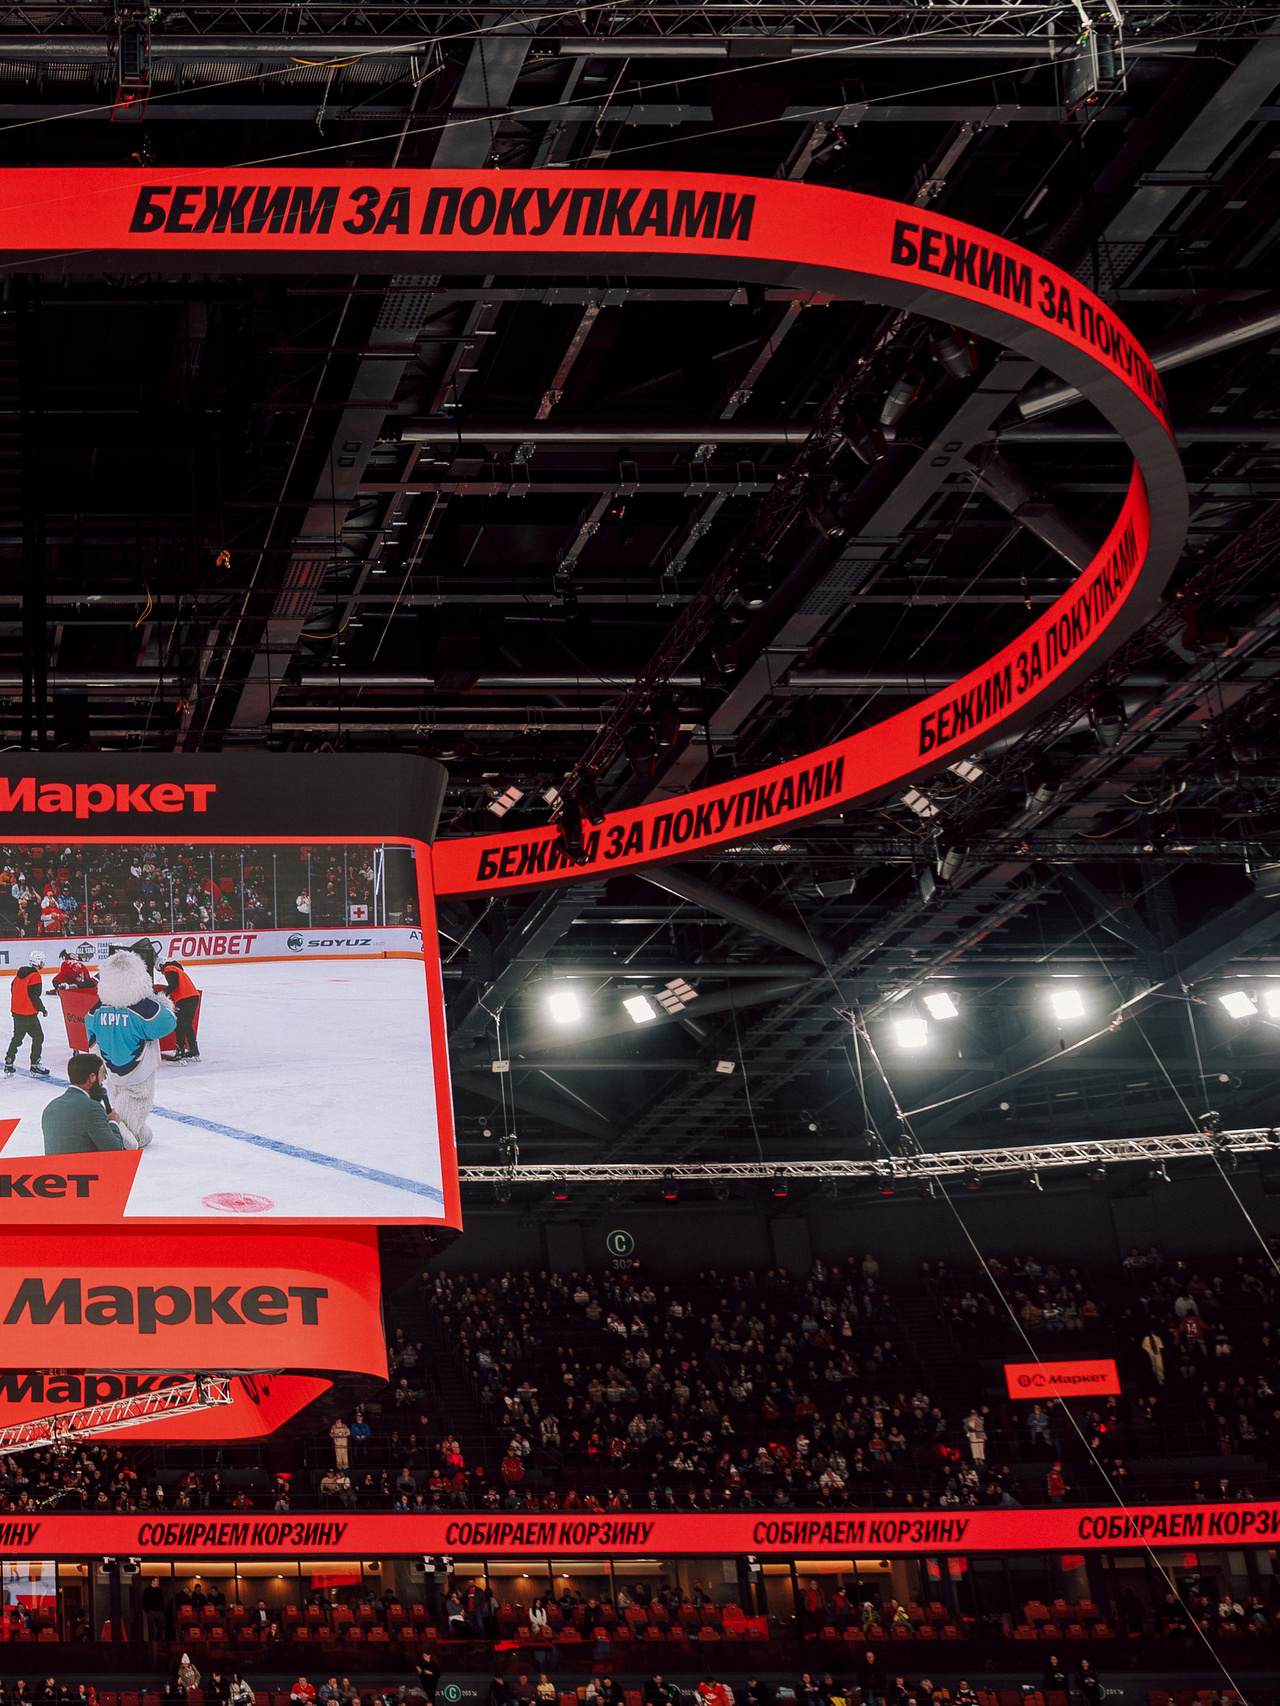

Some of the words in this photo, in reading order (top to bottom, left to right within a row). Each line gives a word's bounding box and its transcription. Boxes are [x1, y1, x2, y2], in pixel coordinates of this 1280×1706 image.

[129, 186, 341, 234] БЕЖИМ
[342, 186, 411, 235] ЗА
[420, 187, 757, 241] ПОКУПКАМИ
[891, 219, 1032, 308] БЕЖИМ
[1039, 274, 1075, 332] ЗА
[919, 663, 1012, 757] БЕЖИМ
[1017, 640, 1043, 695] ЗА
[1046, 516, 1139, 673] ПОКУПКАМИ
[604, 821, 643, 860] ЗА
[650, 756, 846, 850] ПОКУПКАМИ
[169, 934, 257, 958] FONBET
[307, 939, 373, 948] SOYUZ
[100, 1012, 129, 1027] КРУТ
[4, 1278, 329, 1335] Маркет
[1048, 1374, 1108, 1384] Маркет
[138, 1523, 250, 1546] СОБИРАЕМ
[250, 1523, 348, 1546] КОРЗИНУ
[445, 1522, 557, 1545] СОБИРАЕМ
[558, 1522, 655, 1545] КОРЗИНУ
[753, 1521, 866, 1544] СОБИРАЕМ
[868, 1519, 969, 1543] КОРЗИНУ
[1078, 1513, 1205, 1540] СОБИРАЕМ
